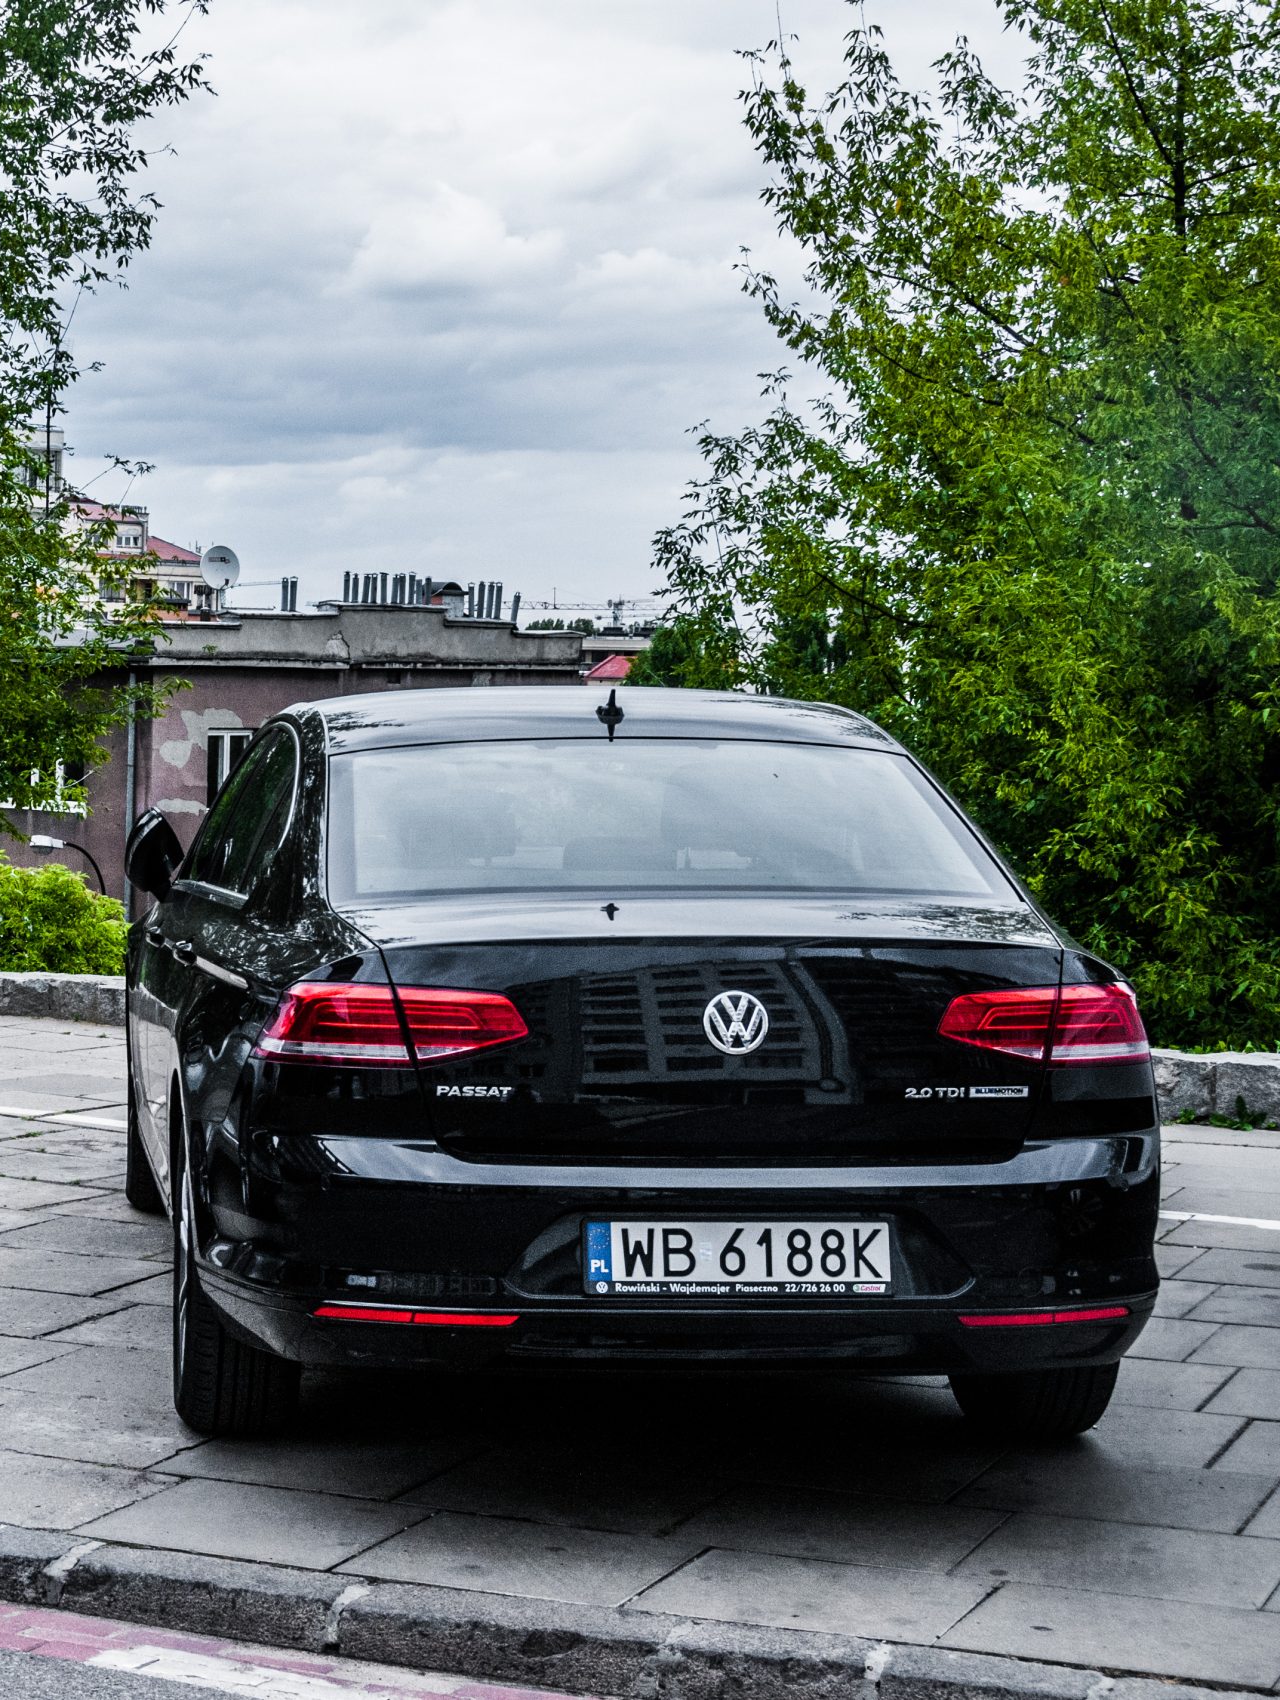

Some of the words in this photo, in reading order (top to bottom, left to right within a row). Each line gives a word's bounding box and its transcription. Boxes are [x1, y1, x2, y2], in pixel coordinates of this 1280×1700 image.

[436, 1085, 512, 1097] PASSAT
[904, 1087, 932, 1098] 2.0
[935, 1087, 965, 1098] TDI
[621, 1228, 696, 1278] WB
[719, 1228, 883, 1278] 6188K
[590, 1259, 609, 1273] PL
[615, 1282, 660, 1293] Rowiński
[669, 1282, 731, 1295] Wajdemajer
[735, 1283, 778, 1293] Piaseczno
[785, 1283, 818, 1293] 22/726
[819, 1283, 831, 1293] 26
[833, 1283, 846, 1293] 00
